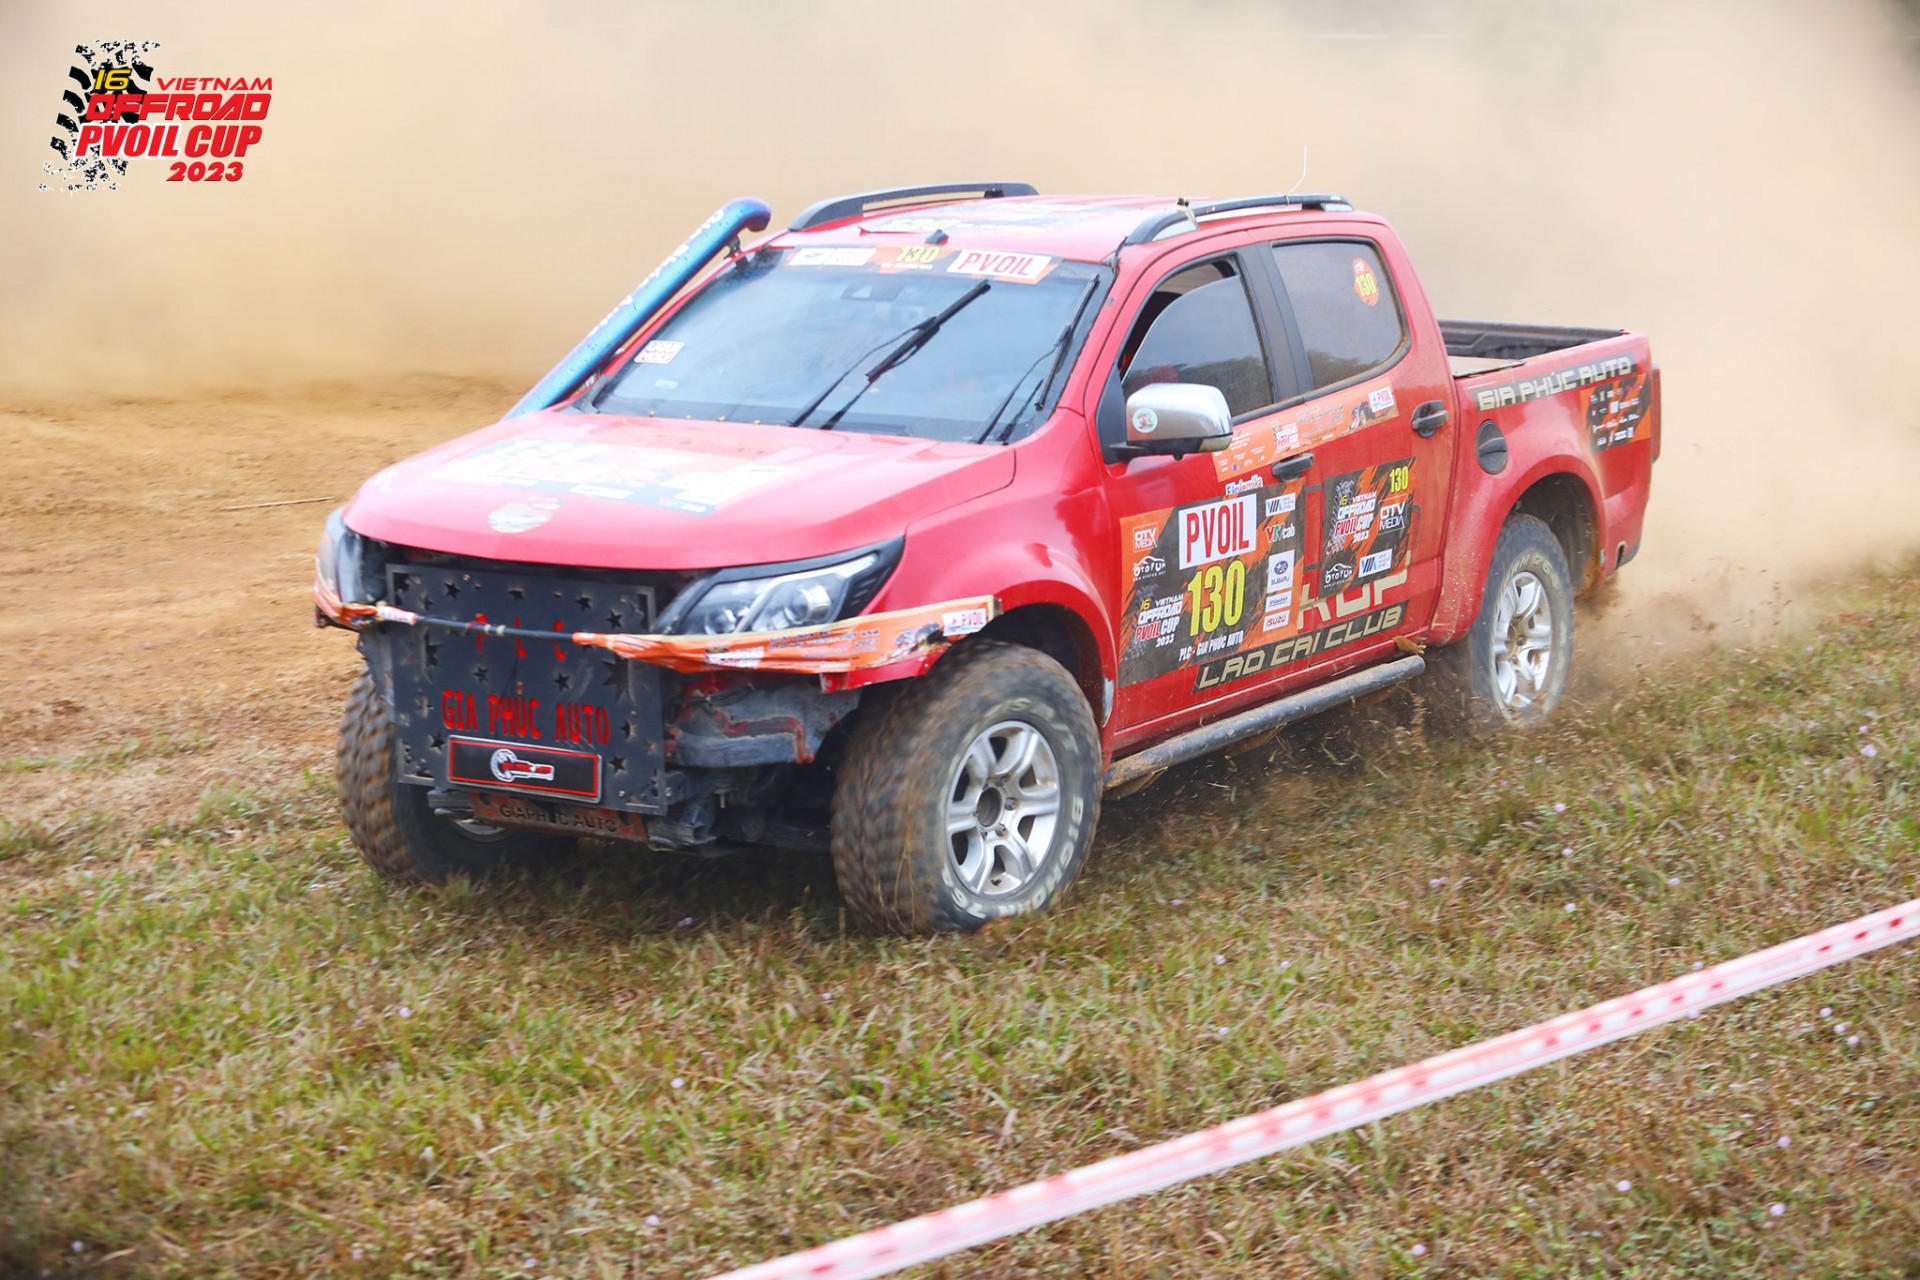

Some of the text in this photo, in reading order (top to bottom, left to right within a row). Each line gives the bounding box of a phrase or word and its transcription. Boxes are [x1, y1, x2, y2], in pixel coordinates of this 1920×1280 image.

[896, 246, 940, 263] 130
[961, 253, 1030, 276] PVOIL
[1355, 272, 1377, 297] 130
[1478, 387, 1517, 411] GIA
[1581, 356, 1632, 385] AUTO
[1389, 466, 1408, 493] 130
[1337, 498, 1377, 520] OFFROAD
[1352, 491, 1377, 503] VIETNAM
[1185, 502, 1250, 564] PVOIL
[1334, 513, 1375, 537] PVOIL CUP
[1271, 576, 1290, 586] SUBARU
[1140, 594, 1184, 611] 16 VIETNAM
[1187, 560, 1246, 637] 130
[1137, 600, 1184, 625] OFFROAD
[1266, 614, 1286, 627] ISUZU
[1134, 616, 1181, 643] PVOIL CUP
[1155, 634, 1175, 648] 2023
[1271, 632, 1320, 667] CAI
[1324, 605, 1402, 650] CLUB
[1179, 645, 1193, 662] PLC
[1227, 630, 1244, 647] AUTO
[442, 689, 479, 733] GIA
[555, 702, 611, 746] AUTO
